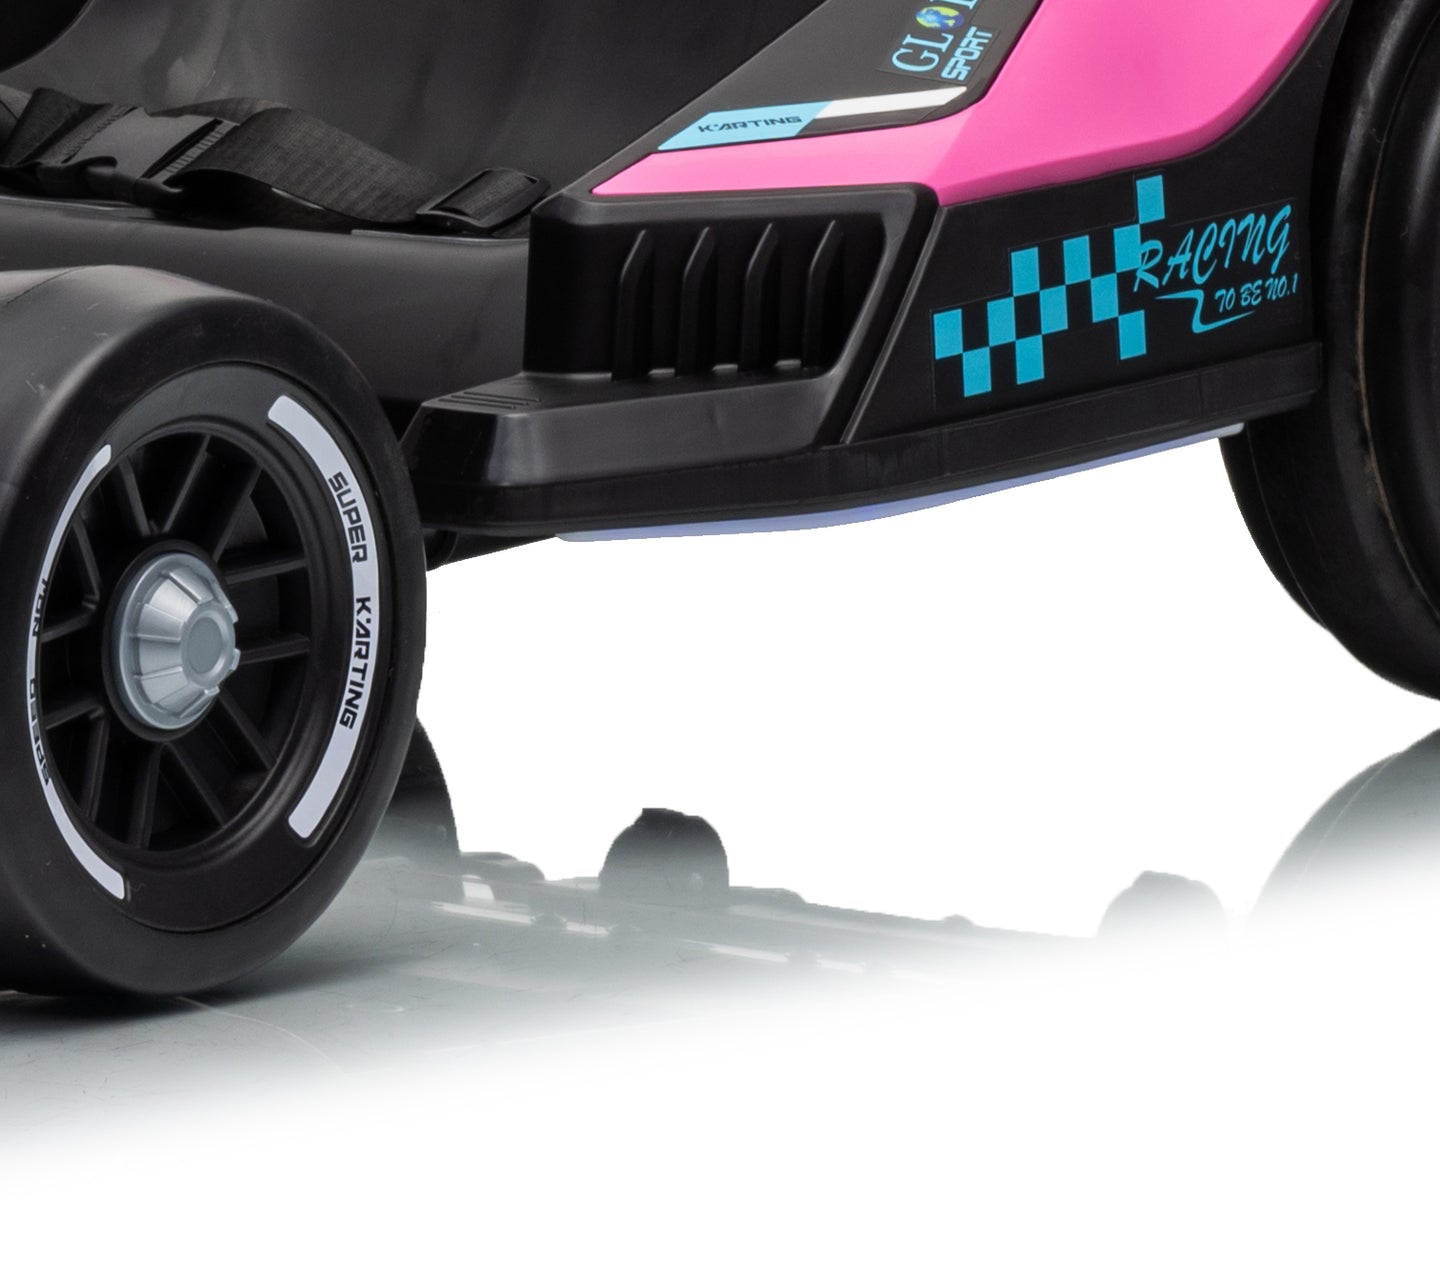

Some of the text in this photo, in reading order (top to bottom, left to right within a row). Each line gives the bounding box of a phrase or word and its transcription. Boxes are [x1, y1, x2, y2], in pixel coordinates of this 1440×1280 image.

[941, 26, 993, 80] SPORT
[1133, 204, 1292, 292] RACING
[1215, 272, 1298, 312] TO BE NO.1
[328, 471, 368, 563] SUPER
